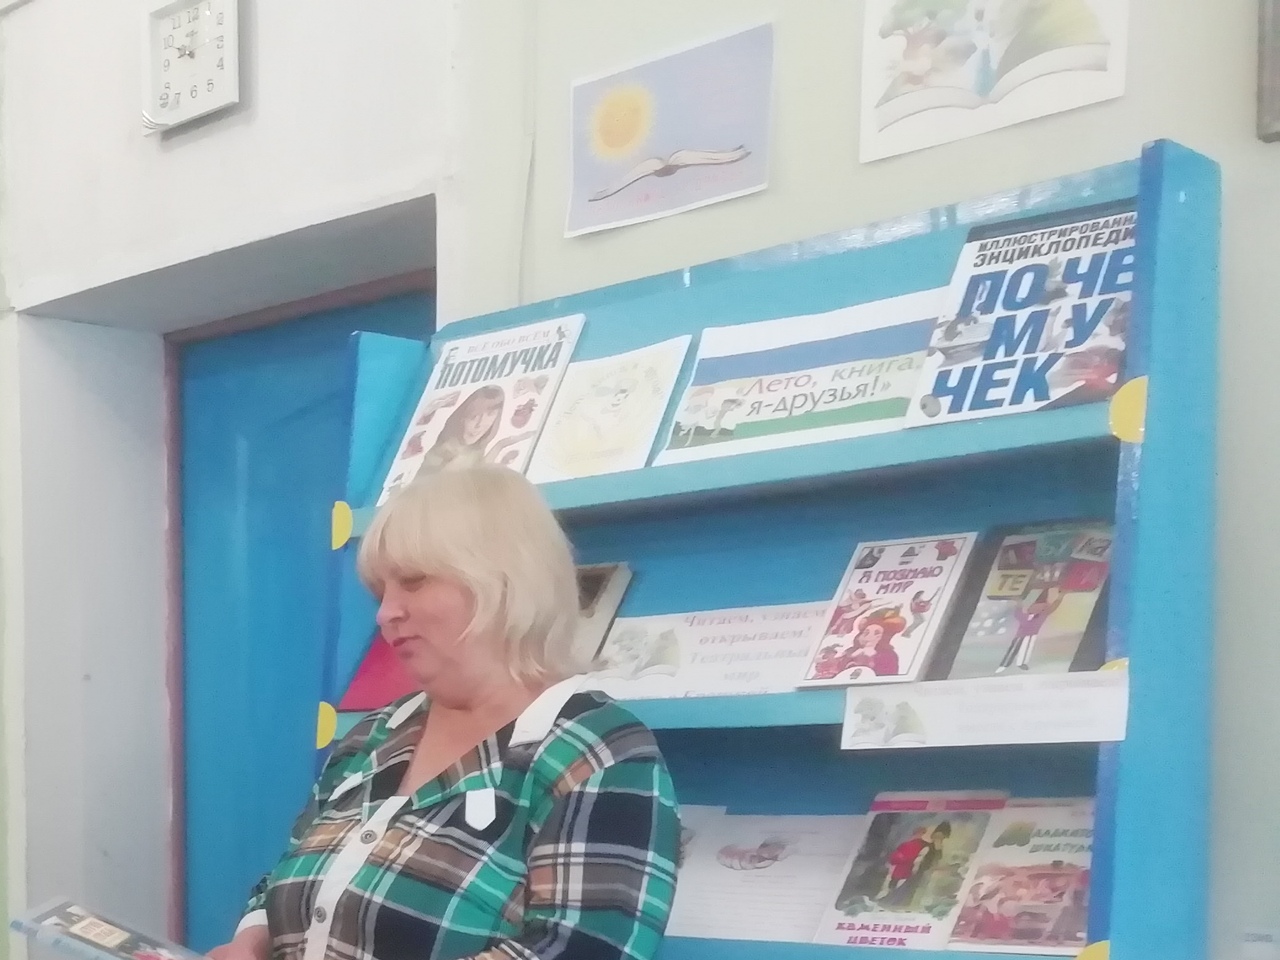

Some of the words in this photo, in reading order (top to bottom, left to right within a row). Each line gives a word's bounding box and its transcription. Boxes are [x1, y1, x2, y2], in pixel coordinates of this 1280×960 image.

[190, 84, 198, 99] 6
[206, 78, 214, 93] 5
[434, 340, 565, 390] ПОТОМУЧКА
[931, 352, 1064, 415] ЧЕК
[858, 570, 873, 583] Я
[874, 566, 943, 583] ПОЗНАЮ
[876, 580, 914, 594] МИР
[835, 922, 932, 934] КАМЕННЫЙ
[846, 936, 908, 947] ЦВЕТОК
